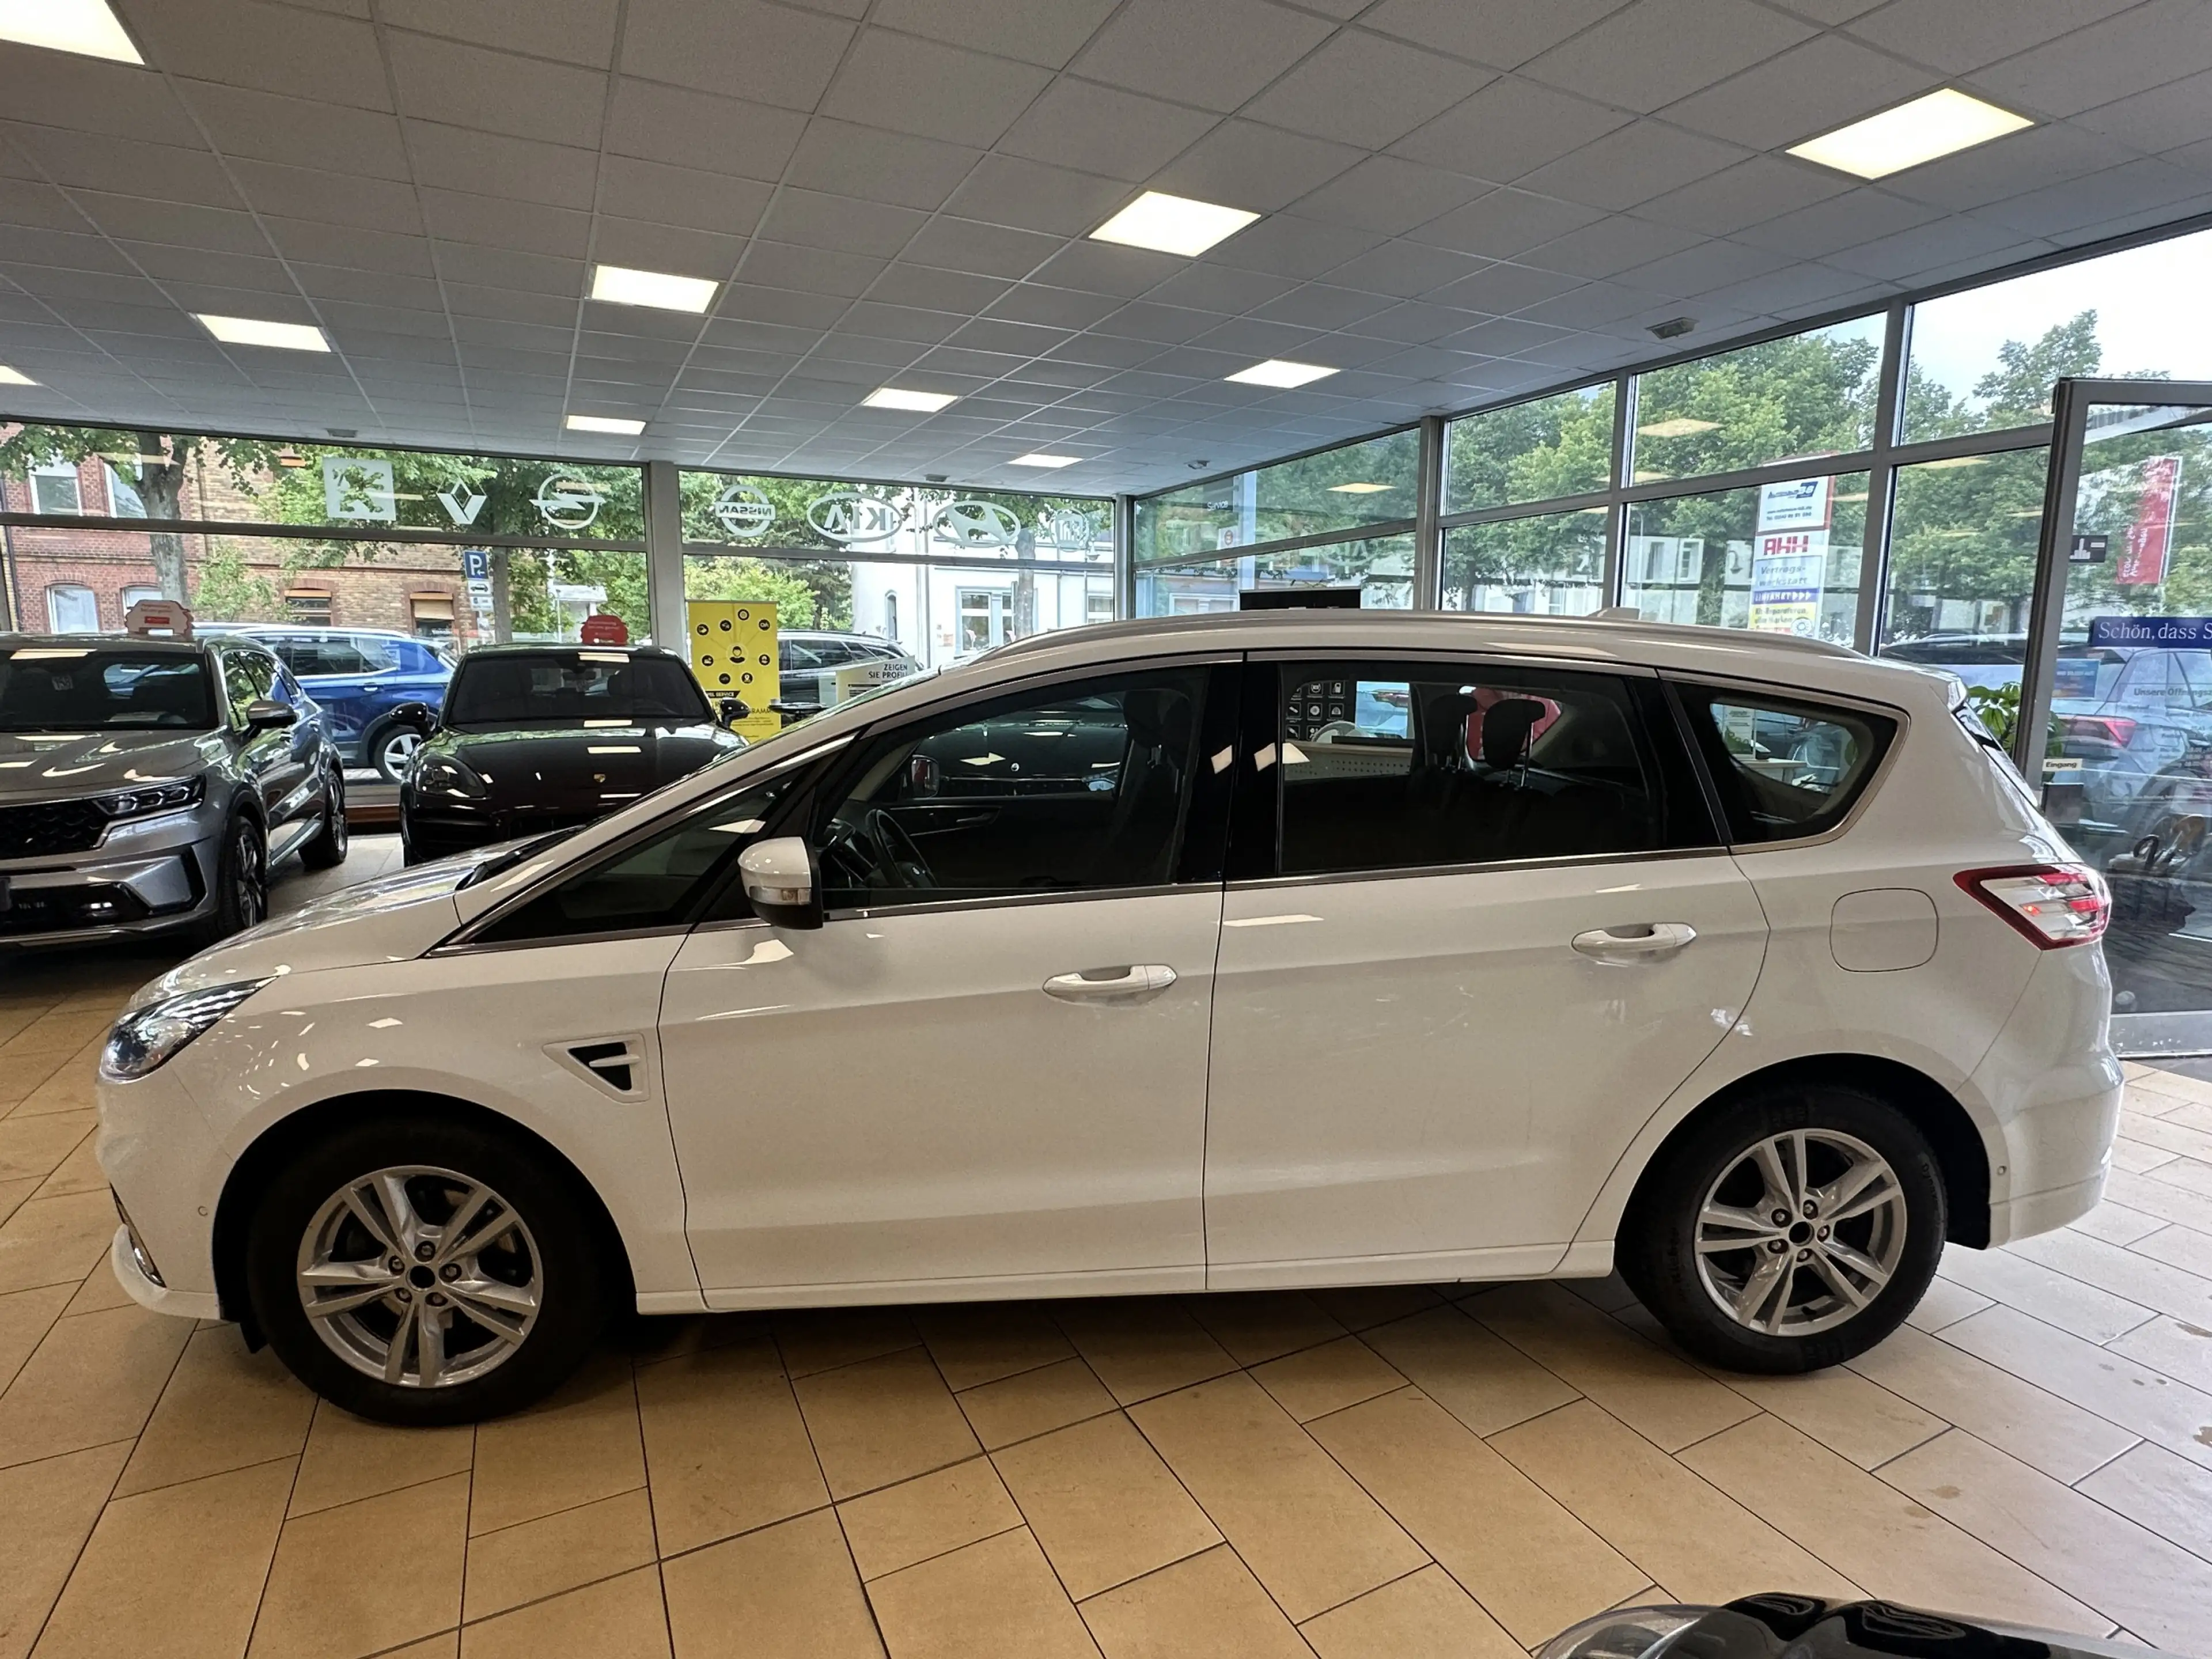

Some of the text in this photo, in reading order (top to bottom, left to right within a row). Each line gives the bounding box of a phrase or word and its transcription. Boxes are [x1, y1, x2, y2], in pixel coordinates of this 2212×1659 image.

[469, 554, 483, 576] P
[2098, 622, 2155, 641] Schön,
[2157, 623, 2196, 639] dass
[2133, 688, 2166, 696] Unsere
[2046, 761, 2078, 769] Eingang
